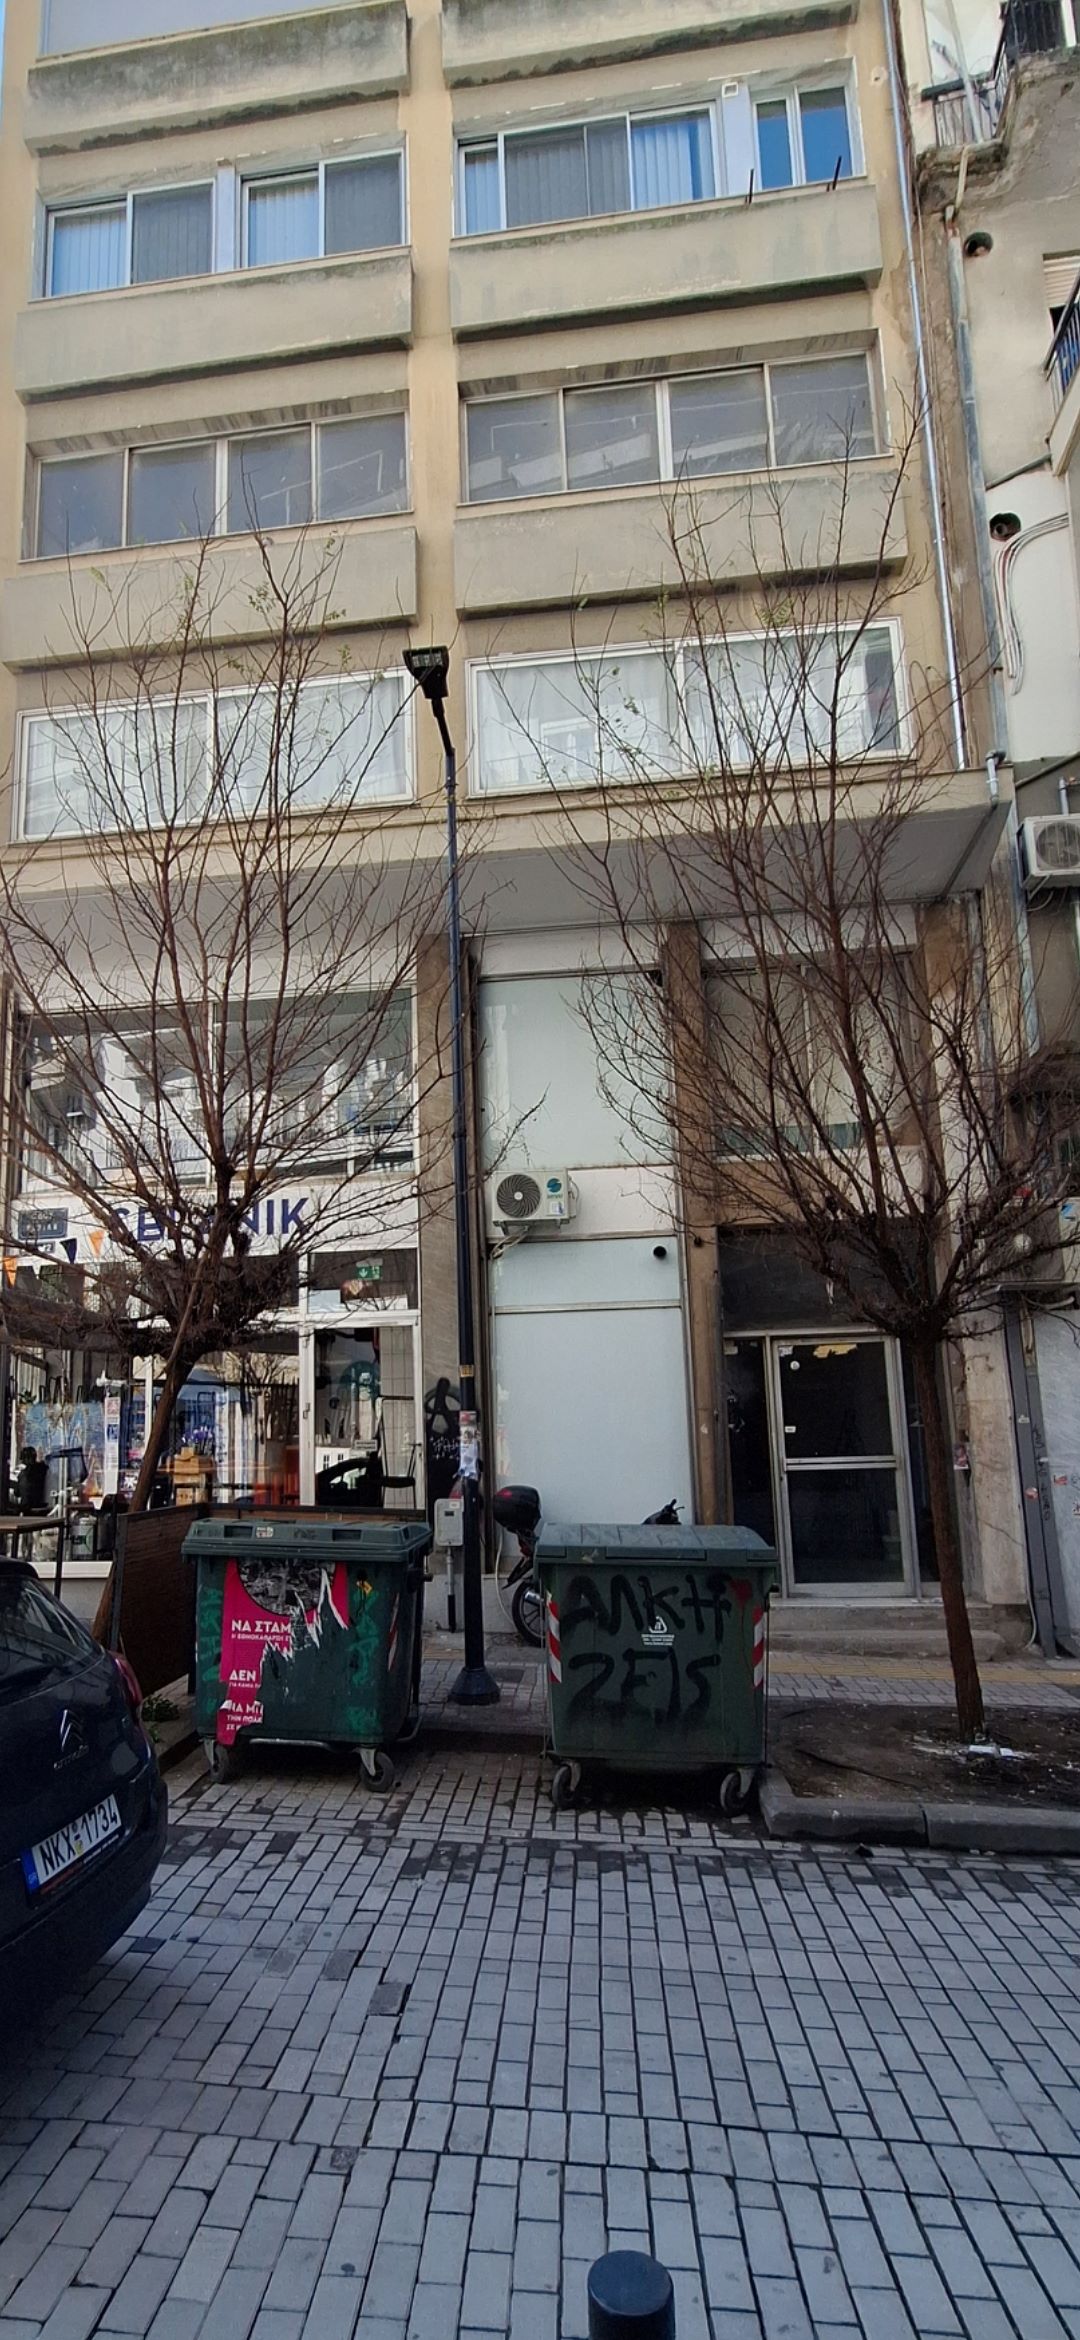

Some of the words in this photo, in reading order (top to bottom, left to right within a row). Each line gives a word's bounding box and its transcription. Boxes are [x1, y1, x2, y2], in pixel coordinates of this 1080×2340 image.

[112, 1197, 310, 1242] ENIK
[231, 1619, 252, 1632] ΝΑ
[229, 1669, 257, 1682] ΔΕΝ
